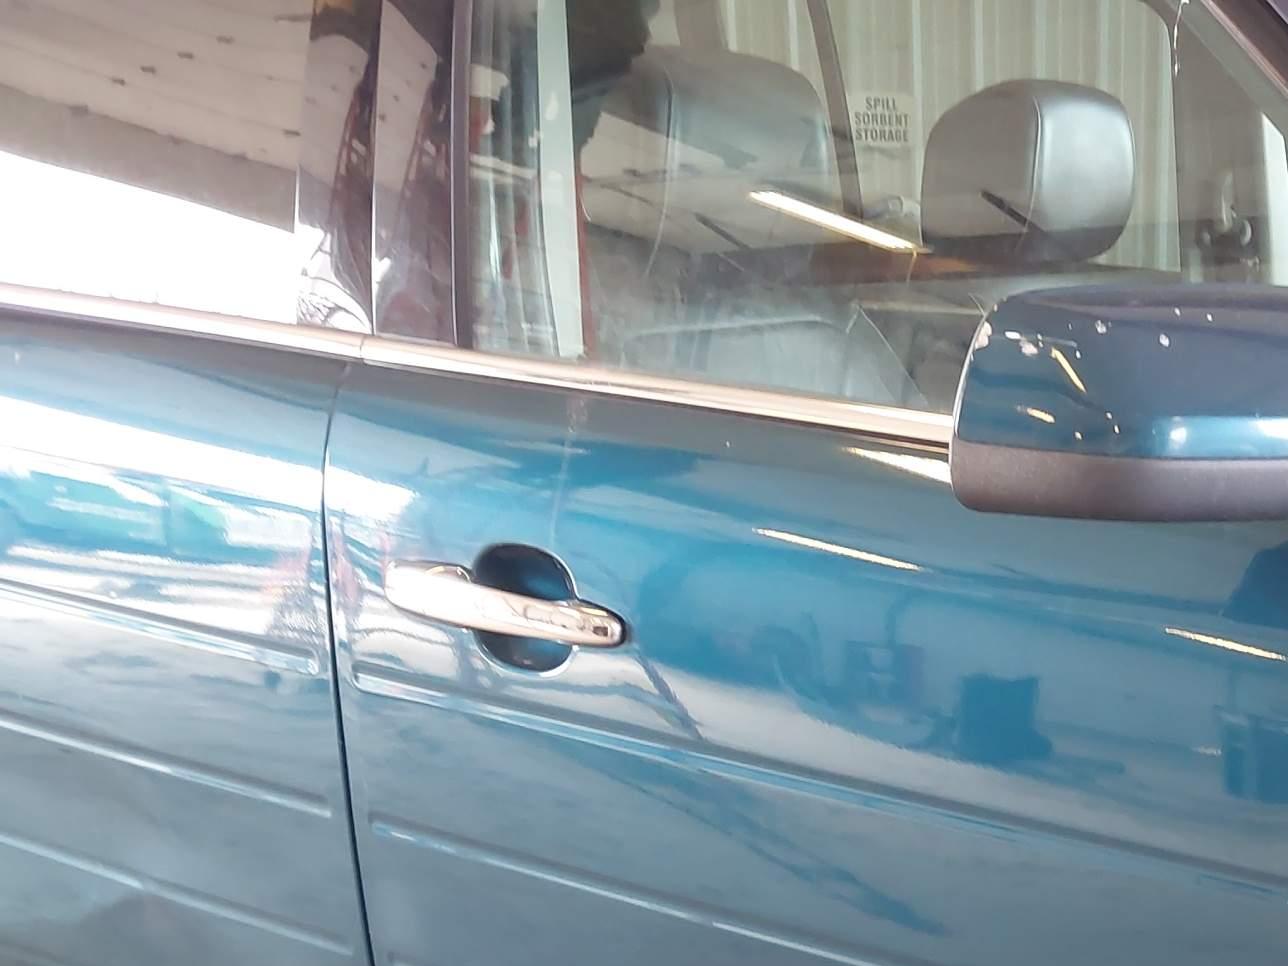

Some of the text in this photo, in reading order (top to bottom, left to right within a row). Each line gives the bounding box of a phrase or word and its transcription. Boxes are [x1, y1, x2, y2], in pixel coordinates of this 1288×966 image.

[865, 97, 897, 111] SPILL
[854, 112, 909, 127] SORBENT
[855, 128, 909, 142] STORAGE
